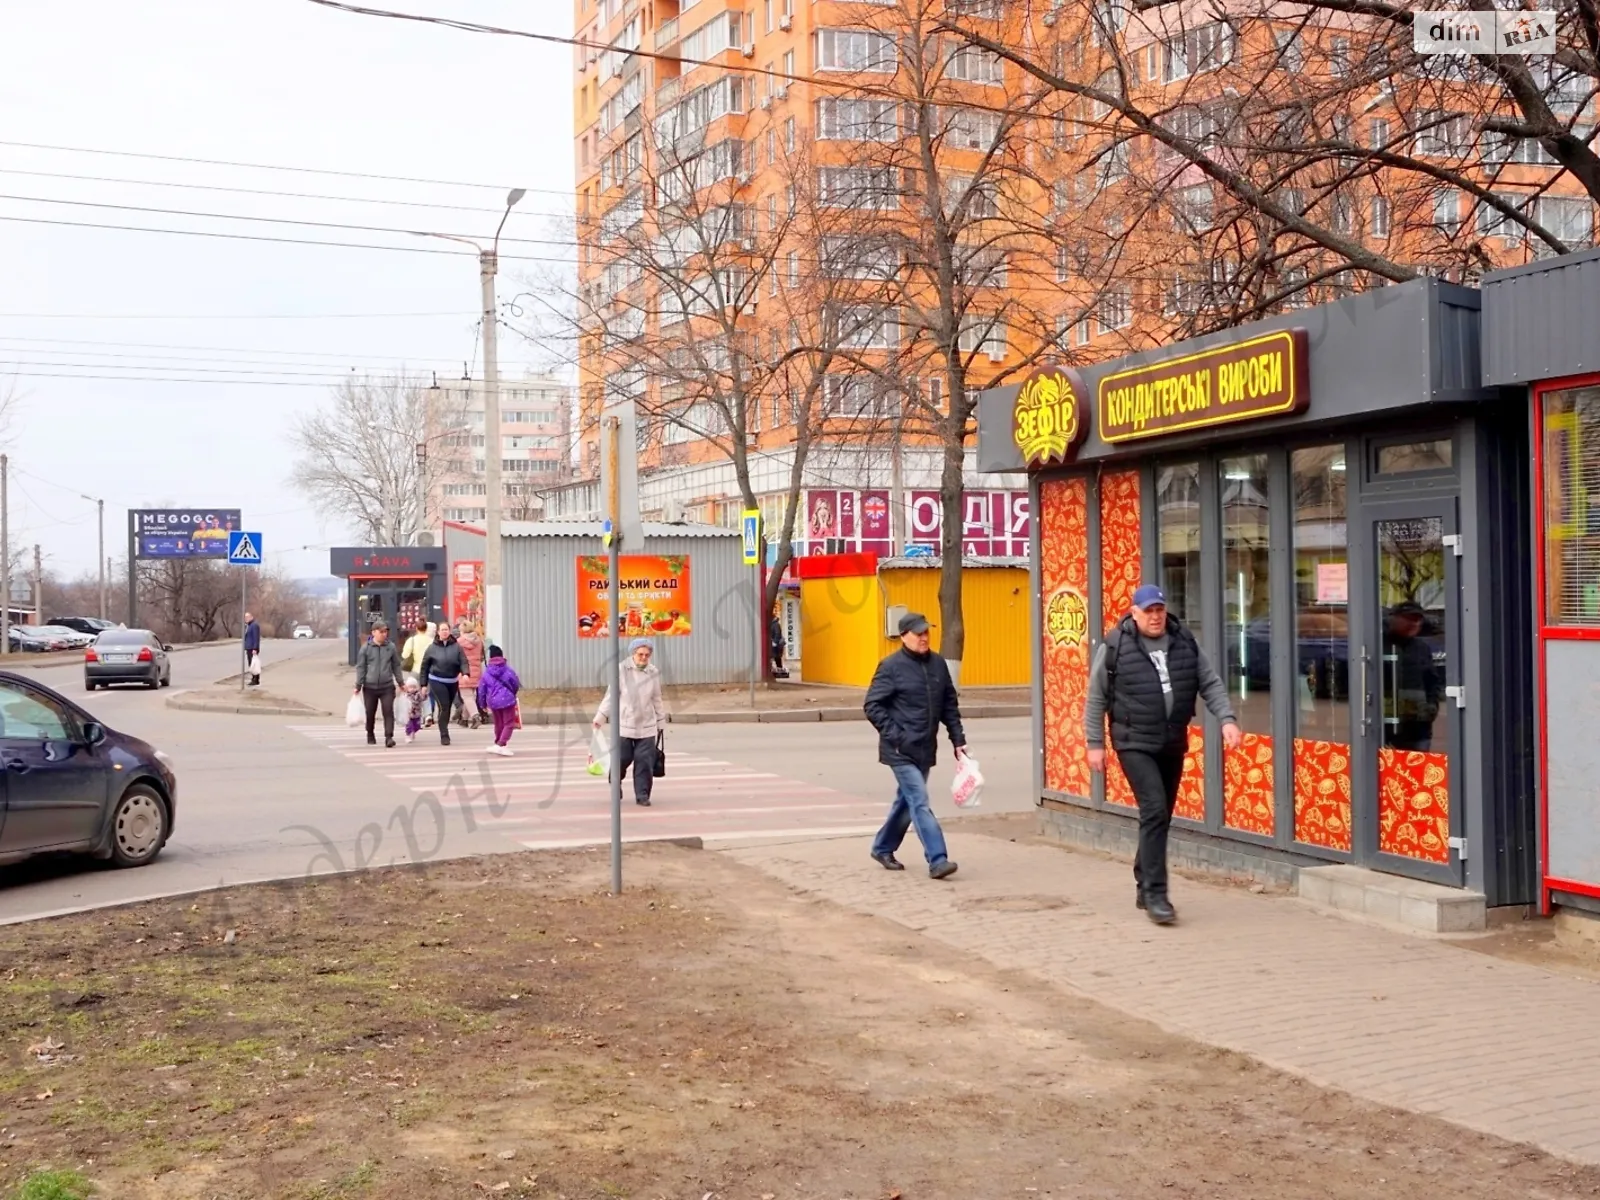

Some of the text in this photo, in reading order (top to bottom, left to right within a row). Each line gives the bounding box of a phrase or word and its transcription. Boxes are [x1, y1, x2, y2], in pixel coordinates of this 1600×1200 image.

[1107, 351, 1282, 430] КОНДИТЕРСЬКІ ВИРОБИ
[1017, 401, 1073, 439] ЗЕФІР
[843, 498, 851, 511] 2
[589, 578, 678, 590] РАЙЬКИЙ САД
[1050, 611, 1084, 630] ЗЕФІР
[1407, 808, 1434, 825] Bakery
